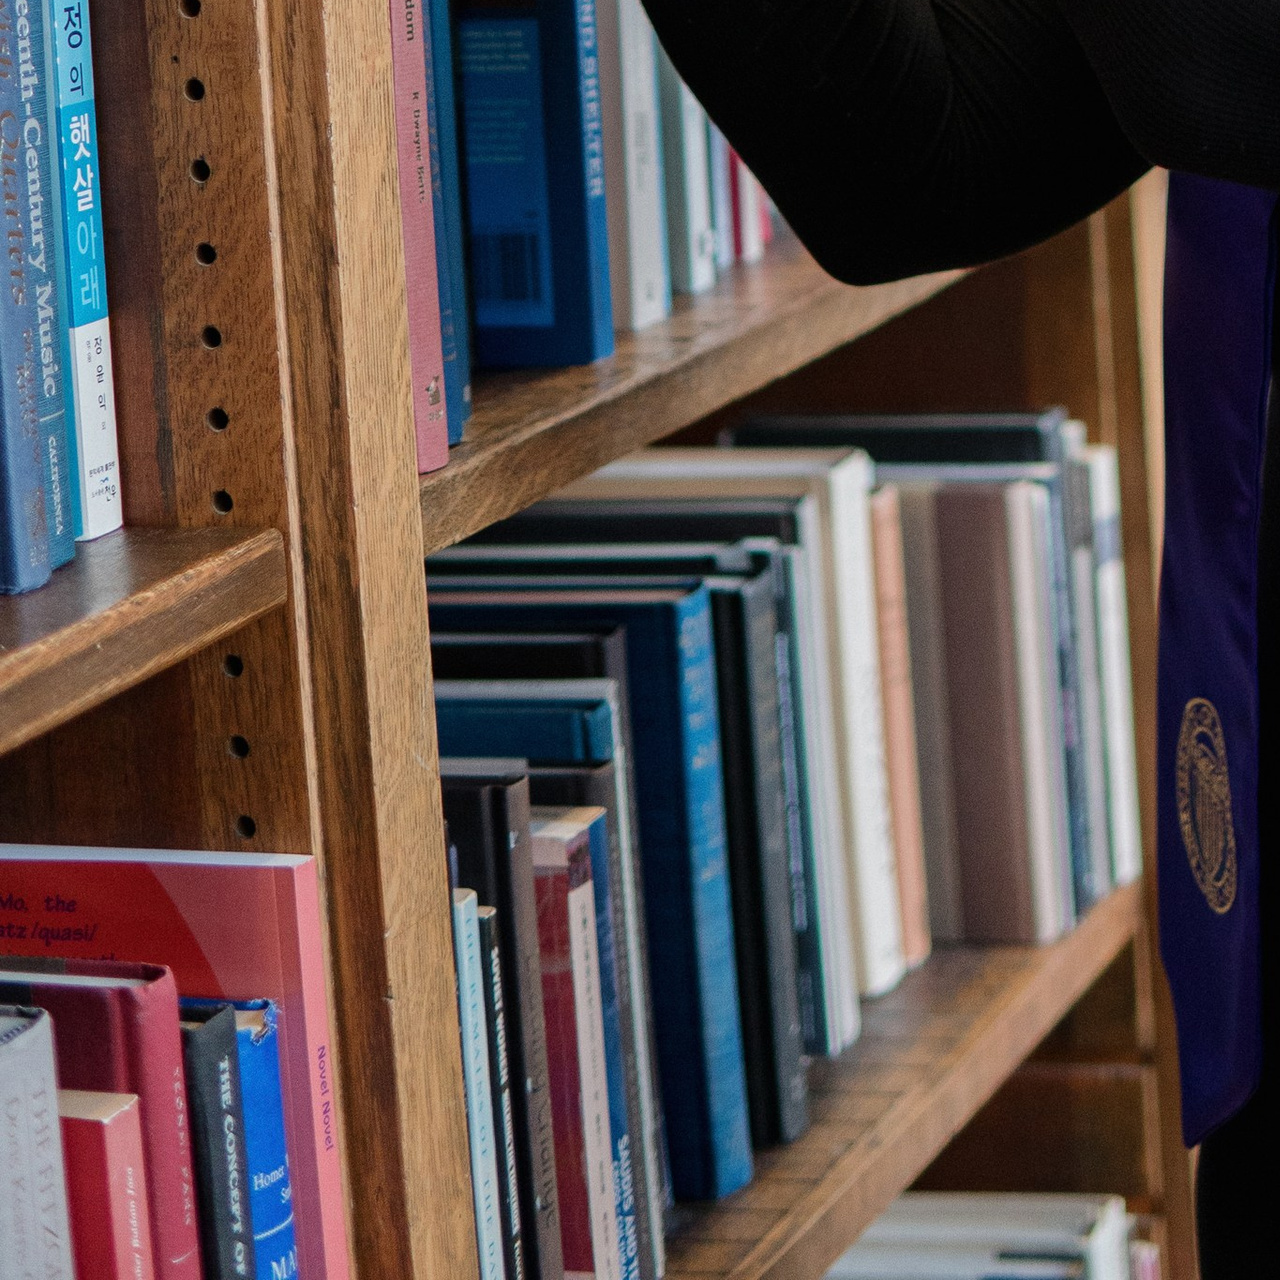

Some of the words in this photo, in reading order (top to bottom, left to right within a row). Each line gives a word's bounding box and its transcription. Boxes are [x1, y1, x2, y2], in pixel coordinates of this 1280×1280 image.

[413, 107, 423, 162] Dwayne
[583, 54, 604, 197] SHELTER
[0, 109, 27, 306] Quarters
[35, 285, 57, 398] Music
[48, 436, 64, 535] CALIFORNIA
[44, 894, 77, 913] the
[491, 946, 504, 1011] SOVIET
[317, 1044, 330, 1096] Novel
[469, 983, 485, 1113] REMAINS
[496, 1013, 509, 1085] WOMEN
[219, 1054, 232, 1109] THE
[322, 1101, 334, 1151] Novel
[181, 1167, 191, 1225] PARK
[223, 1114, 243, 1234] CONCEPT
[252, 1165, 285, 1191] Homer
[617, 1134, 635, 1212] SAUDIS
[234, 1242, 247, 1276] OF
[624, 1214, 638, 1259] AND
